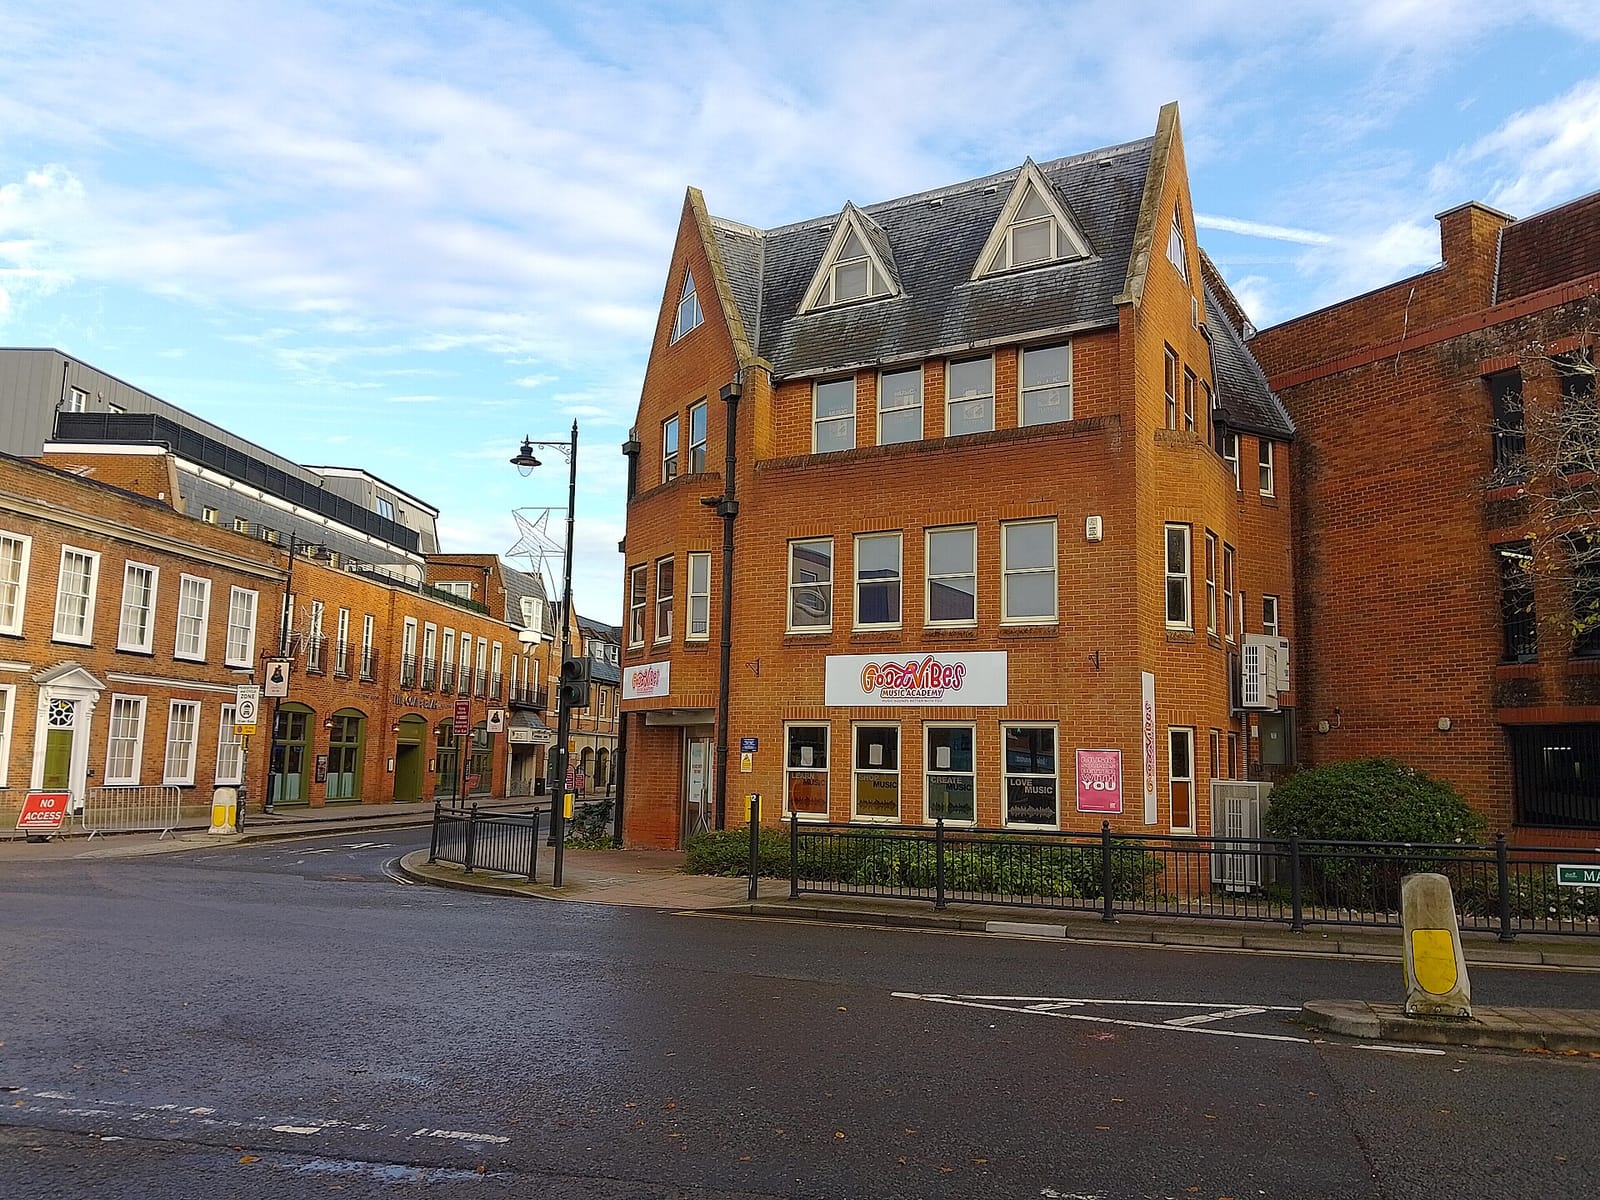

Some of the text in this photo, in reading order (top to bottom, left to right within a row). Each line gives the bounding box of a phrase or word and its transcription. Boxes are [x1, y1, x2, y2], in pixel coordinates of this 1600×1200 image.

[882, 689, 942, 697] MUSIC ACADEMY
[930, 776, 962, 784] CREATE
[873, 781, 897, 789] MUSIC
[946, 783, 972, 791] MUSIC
[1082, 781, 1116, 791] YOU
[1025, 786, 1053, 794] MUSIC
[751, 794, 757, 802] 2
[40, 799, 54, 808] NO
[24, 811, 61, 821] ACCESS
